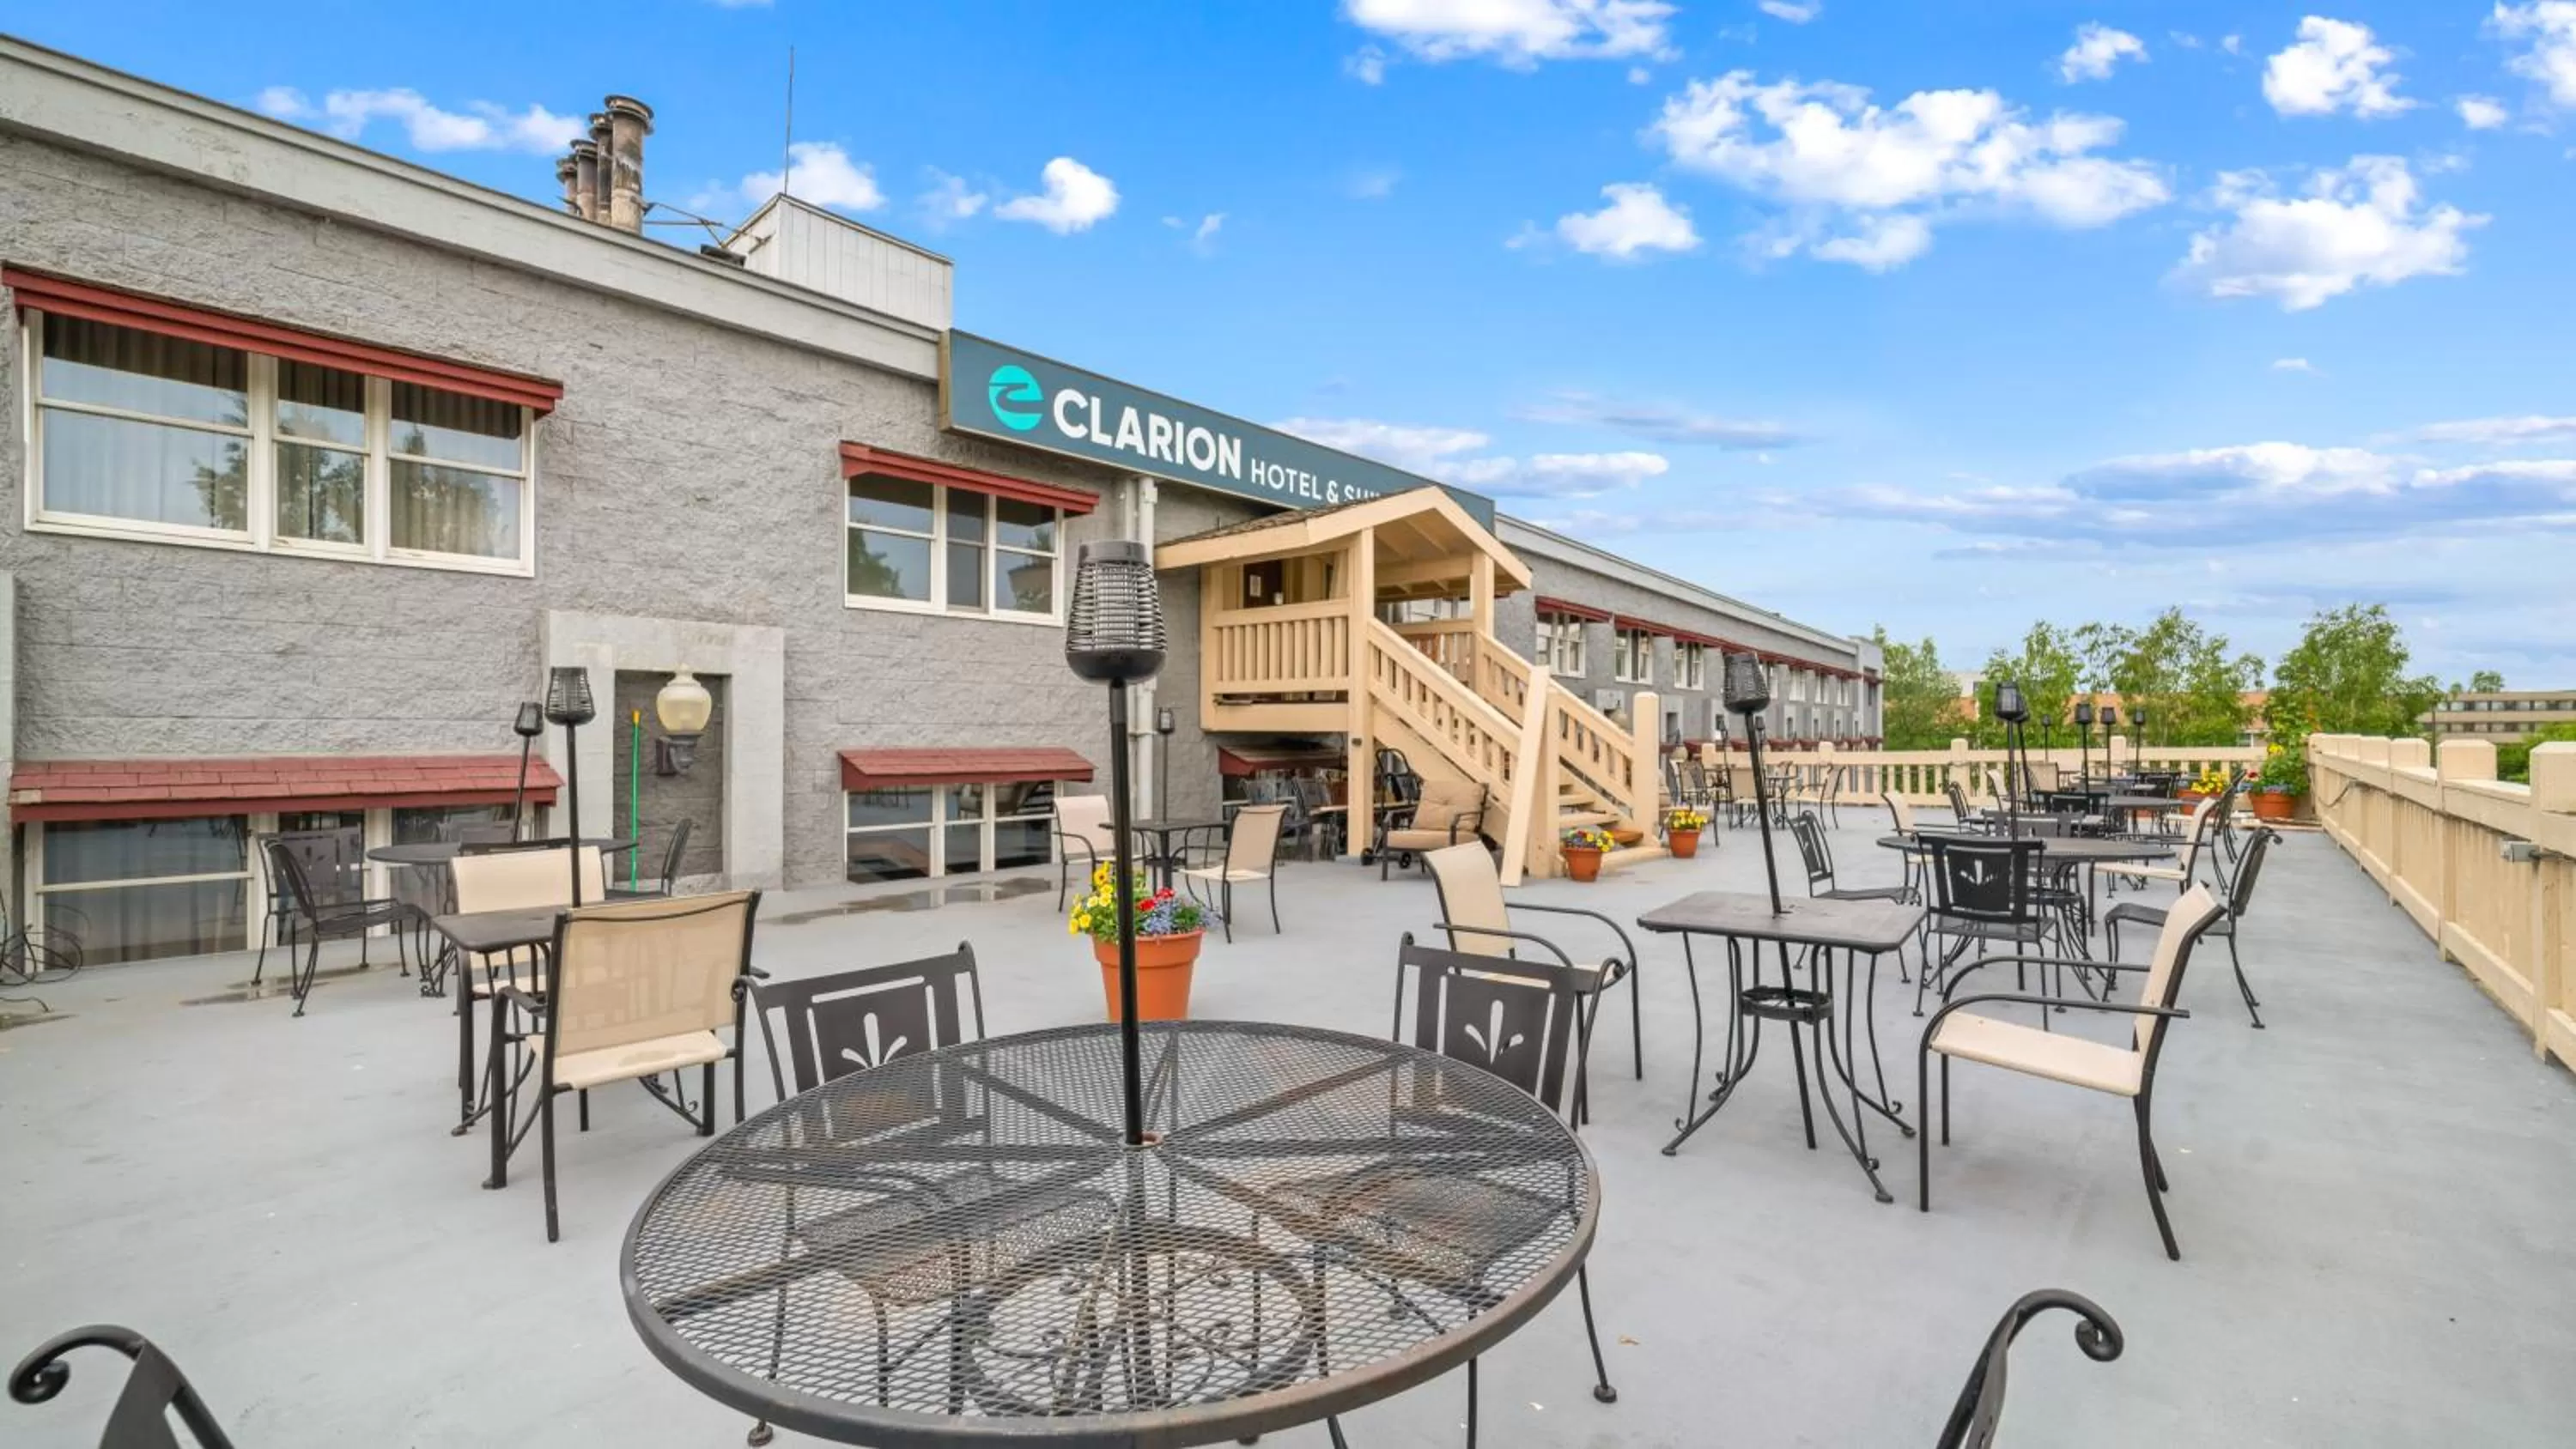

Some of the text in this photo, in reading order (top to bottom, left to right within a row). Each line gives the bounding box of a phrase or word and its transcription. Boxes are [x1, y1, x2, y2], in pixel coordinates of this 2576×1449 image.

[1054, 389, 1241, 480] CLARION
[1251, 458, 1322, 500] HOTEL
[1327, 480, 1339, 504] &
